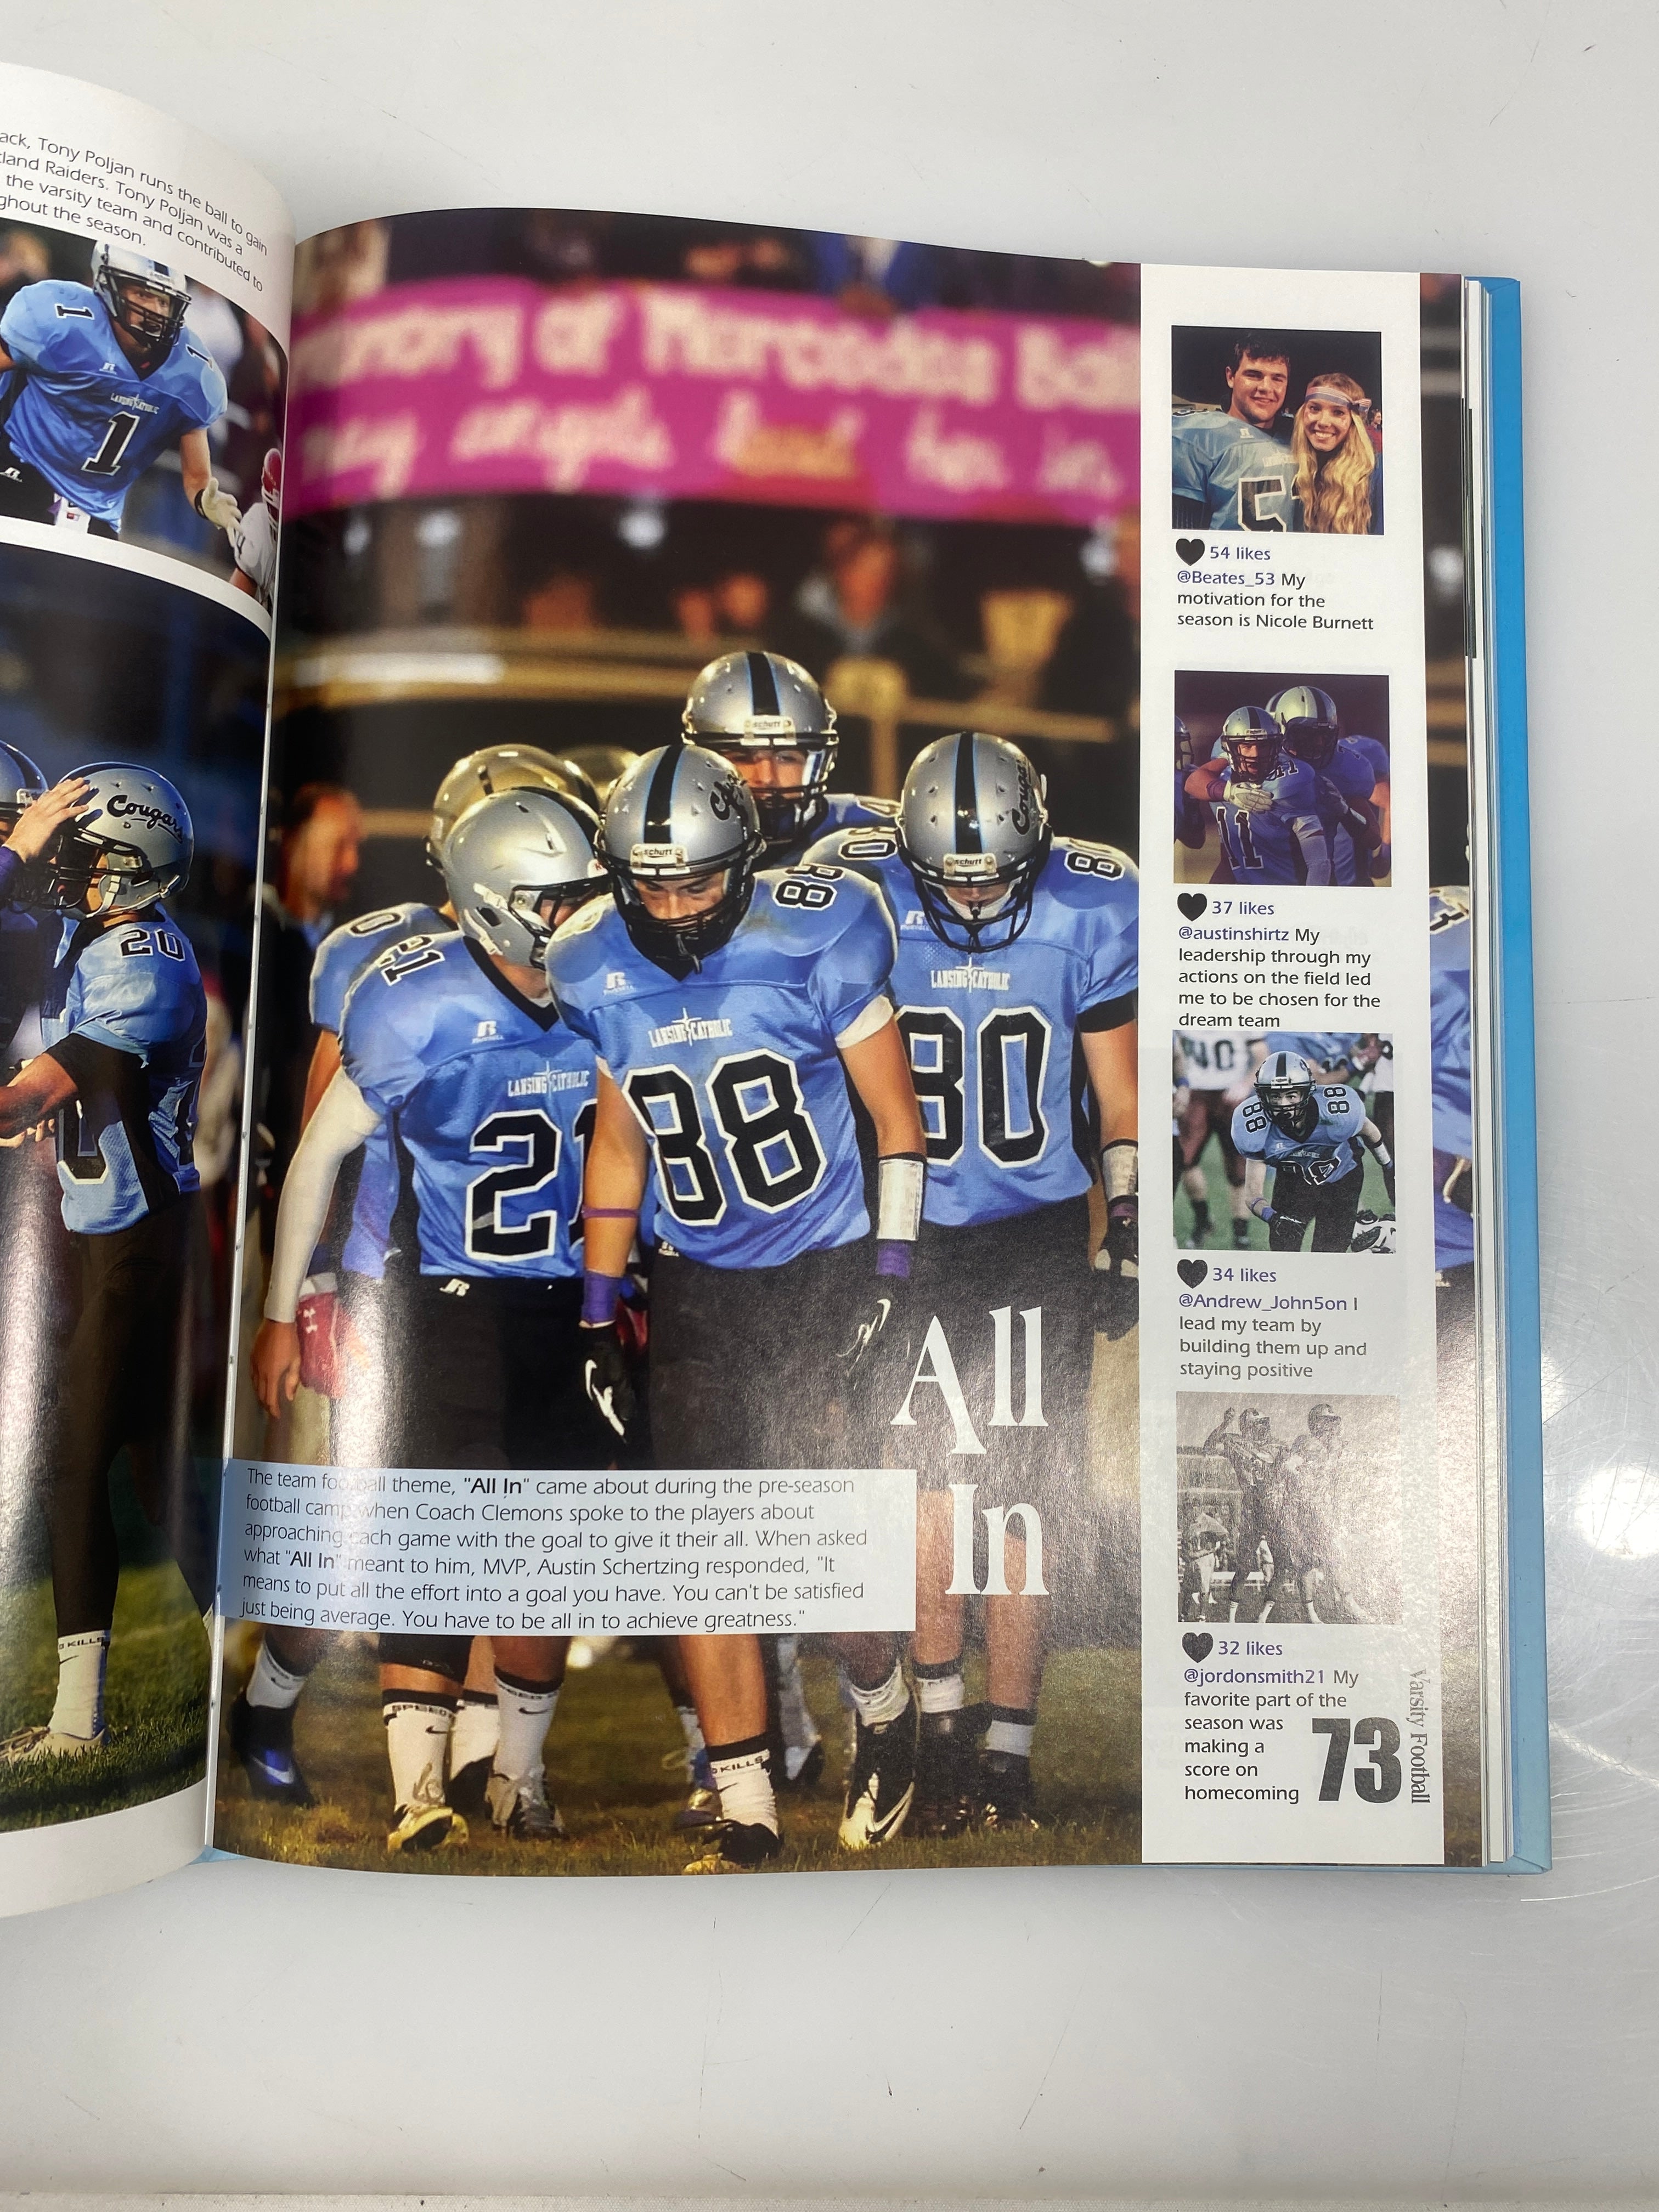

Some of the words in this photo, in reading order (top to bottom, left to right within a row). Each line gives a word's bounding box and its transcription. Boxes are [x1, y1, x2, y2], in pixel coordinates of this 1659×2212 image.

[38, 137, 80, 162] Tony
[86, 150, 134, 178] Poljan
[140, 172, 173, 194] runs
[178, 188, 201, 208] the
[205, 201, 227, 224] ball
[232, 219, 242, 234] to
[246, 232, 267, 255] gain
[46, 160, 109, 190] Raiders.
[116, 181, 155, 208] Tony
[160, 199, 202, 230] Poljan
[207, 225, 232, 247] was
[7, 174, 33, 190] the
[39, 183, 92, 207] varsity
[97, 198, 137, 221] team
[143, 216, 173, 236] and
[178, 231, 250, 281] contributed
[54, 206, 81, 223] the
[87, 217, 145, 246] season.
[81, 411, 139, 476] 1
[1210, 546, 1230, 559] 54
[1237, 547, 1270, 560] likes
[1177, 571, 1274, 587] @Beates_53
[1282, 573, 1305, 590] My
[1178, 592, 1265, 606] motivation
[1271, 594, 1293, 607] for
[1299, 595, 1325, 607] the
[1178, 615, 1233, 626] season
[1257, 614, 1307, 628] Nicole
[1313, 616, 1373, 630] Burnett
[1212, 901, 1232, 914] 37
[1240, 901, 1274, 915] likes
[120, 928, 185, 962] 20
[1179, 926, 1289, 941] @austinshirtz
[1296, 929, 1319, 945] My
[1180, 948, 1265, 966] leadership
[1271, 950, 1339, 967] through
[1346, 954, 1371, 968] my
[1179, 970, 1238, 983] actions
[1244, 974, 1265, 984] on
[1271, 971, 1299, 984] the
[1304, 972, 1339, 985] field
[1346, 973, 1370, 985] led
[1179, 994, 1204, 1005] me
[1233, 992, 1253, 1005] be
[1259, 992, 1318, 1006] chosen
[1324, 994, 1348, 1007] for
[1353, 994, 1380, 1007] the
[1179, 1013, 1232, 1026] dream
[1238, 1015, 1279, 1027] team
[622, 1048, 827, 1226] 88
[1213, 1268, 1234, 1281] 34
[1241, 1268, 1276, 1282] likes
[1179, 1294, 1347, 1311] @Andrew_John5on
[1180, 1316, 1215, 1330] lead
[1222, 1320, 1247, 1335] my
[1252, 1319, 1294, 1331] team
[1301, 1319, 1321, 1336] by
[1180, 1339, 1250, 1357] building
[1256, 1340, 1300, 1354] them
[1307, 1345, 1328, 1359] up
[1334, 1342, 1366, 1356] and
[890, 1306, 1048, 1454] All
[1180, 1362, 1241, 1380] staying
[1248, 1363, 1312, 1380] positive
[247, 1468, 273, 1486] The
[278, 1472, 315, 1488] team
[393, 1476, 455, 1495] theme,
[465, 1478, 495, 1493] "All
[504, 1478, 529, 1493] In"
[537, 1482, 587, 1494] came
[594, 1479, 648, 1494] about
[655, 1478, 716, 1499] during
[723, 1478, 752, 1493] the
[759, 1481, 854, 1498] pre-season
[247, 1494, 300, 1514] football
[416, 1503, 474, 1520] Coach
[482, 1504, 562, 1521] Clemons
[569, 1505, 623, 1526] spoke
[656, 1505, 685, 1521] the
[692, 1504, 754, 1525] players
[761, 1504, 814, 1520] about
[245, 1523, 342, 1548] approaching
[398, 1533, 450, 1551] game
[458, 1532, 497, 1548] with
[505, 1532, 535, 1548] the
[542, 1532, 582, 1553] goal
[614, 1532, 653, 1553] give
[676, 1531, 718, 1547] their
[724, 1531, 748, 1547] all.
[755, 1530, 810, 1546] When
[817, 1530, 866, 1545] asked
[945, 1485, 1049, 1595] In
[245, 1547, 280, 1565] what
[286, 1550, 312, 1567] "All
[319, 1553, 341, 1568] In"
[348, 1559, 404, 1573] meant
[436, 1558, 475, 1576] him,
[484, 1559, 530, 1577] MVP,
[537, 1559, 595, 1575] Austin
[603, 1558, 699, 1579] Schertzing
[707, 1557, 809, 1578] responded,
[818, 1556, 834, 1572] "It
[244, 1576, 290, 1592] means
[317, 1583, 345, 1600] put
[351, 1582, 369, 1598] all
[376, 1583, 404, 1599] the
[411, 1584, 460, 1601] effort
[466, 1585, 501, 1601] into
[526, 1586, 566, 1607] goal
[572, 1589, 608, 1607] you
[616, 1585, 665, 1601] have.
[673, 1585, 708, 1601] You
[715, 1584, 759, 1600] can't
[766, 1584, 787, 1600] be
[794, 1582, 864, 1599] satisfied
[239, 1598, 266, 1617] just
[270, 1601, 314, 1626] being
[320, 1610, 394, 1630] average.
[403, 1611, 437, 1627] You
[445, 1612, 489, 1628] have
[551, 1613, 571, 1629] all
[627, 1612, 698, 1629] achieve
[704, 1610, 804, 1633] greatness."
[1218, 1641, 1239, 1655] 32
[1246, 1641, 1282, 1655] likes
[1184, 1668, 1323, 1687] @jordonsmith21
[1334, 1670, 1359, 1688] My
[1184, 1692, 1250, 1706] favorite
[1256, 1694, 1290, 1711] part
[1296, 1693, 1314, 1707] of
[1319, 1693, 1346, 1707] the
[1406, 1668, 1430, 1727] Varsity
[1185, 1719, 1243, 1729] season
[1249, 1719, 1283, 1730] was
[1186, 1739, 1248, 1757] making
[1312, 1717, 1402, 1803] 73
[1410, 1733, 1430, 1803] Football
[1185, 1765, 1229, 1776] score
[1236, 1765, 1257, 1776] on
[1186, 1786, 1299, 1804] homecoming
